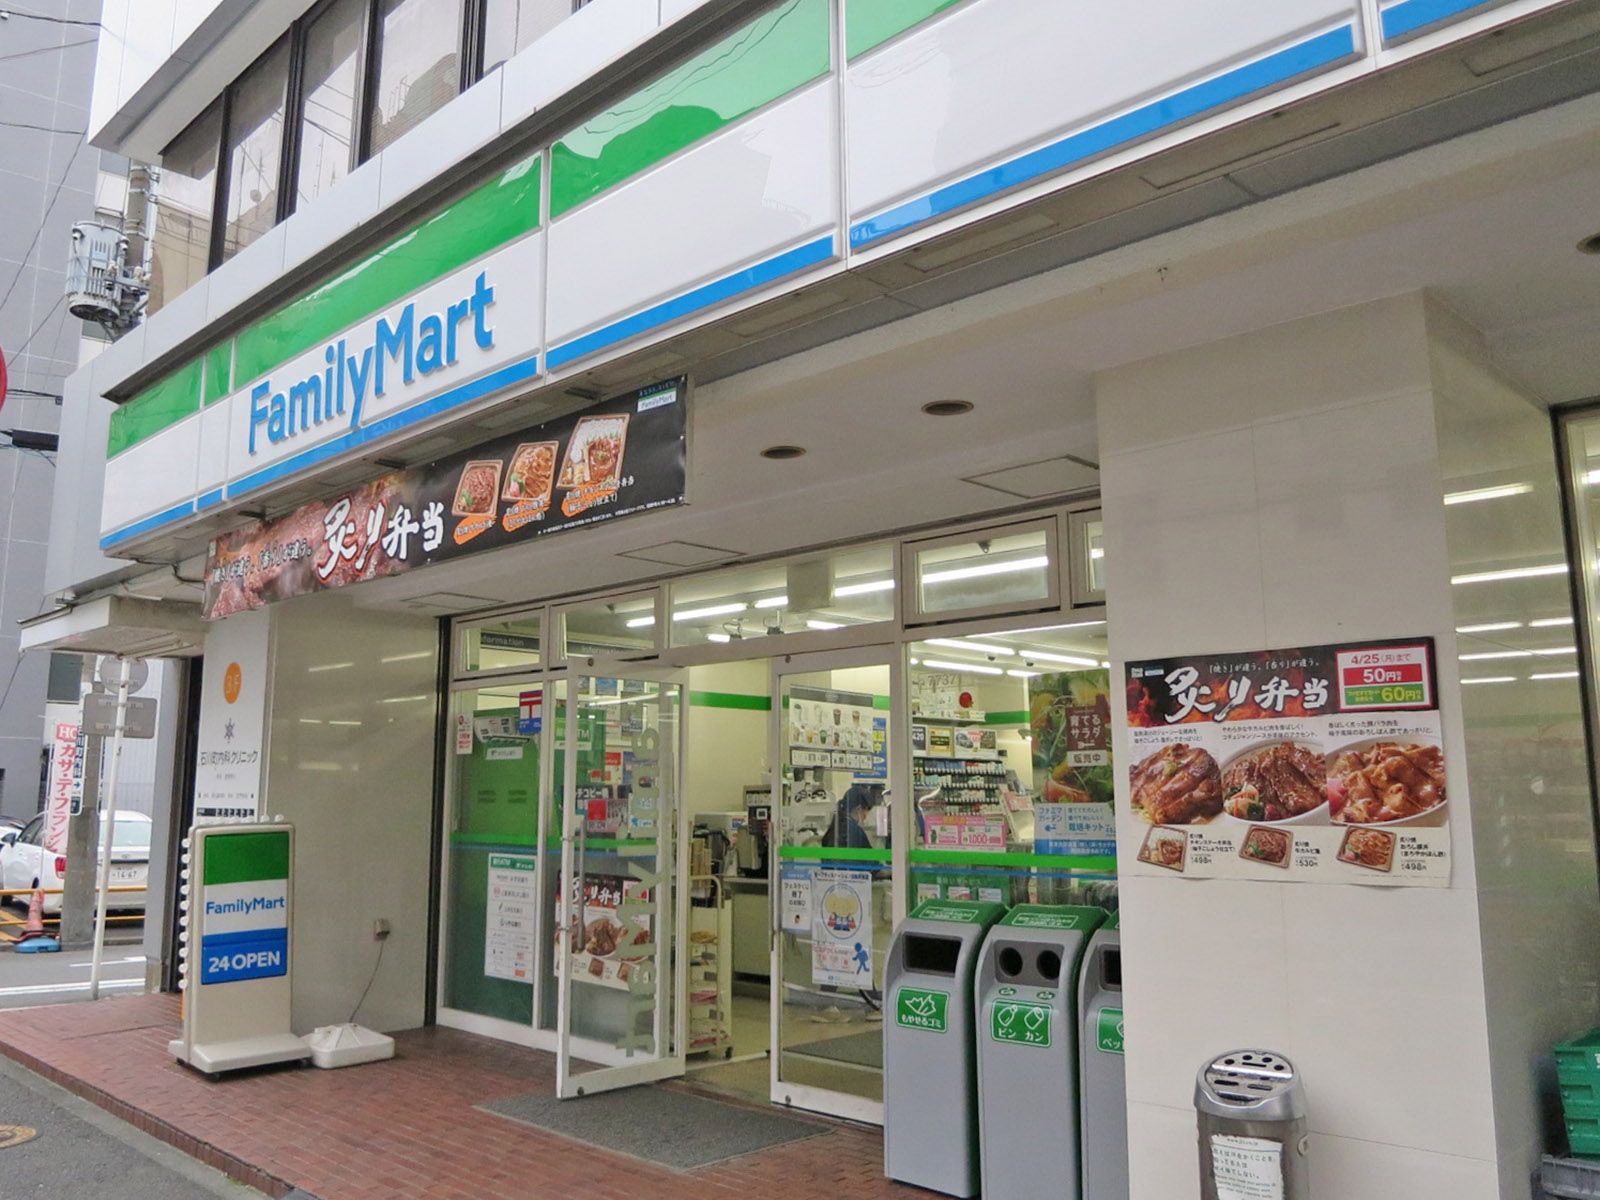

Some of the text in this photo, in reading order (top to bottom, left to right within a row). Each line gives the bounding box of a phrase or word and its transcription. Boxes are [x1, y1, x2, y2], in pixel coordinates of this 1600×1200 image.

[248, 270, 496, 455] FamilyMart
[318, 498, 445, 579] 炙り弁当
[482, 634, 525, 647] formation
[1164, 666, 1329, 724] 炙り弁当
[1070, 714, 1101, 727] 育てる
[1071, 726, 1101, 739] サラダ
[1073, 753, 1101, 764] 販売中
[206, 896, 285, 915] FamilyMart
[231, 951, 281, 970] OPEN
[901, 1015, 942, 1029] もやせるゴミ
[998, 1028, 1044, 1042] ビン カン
